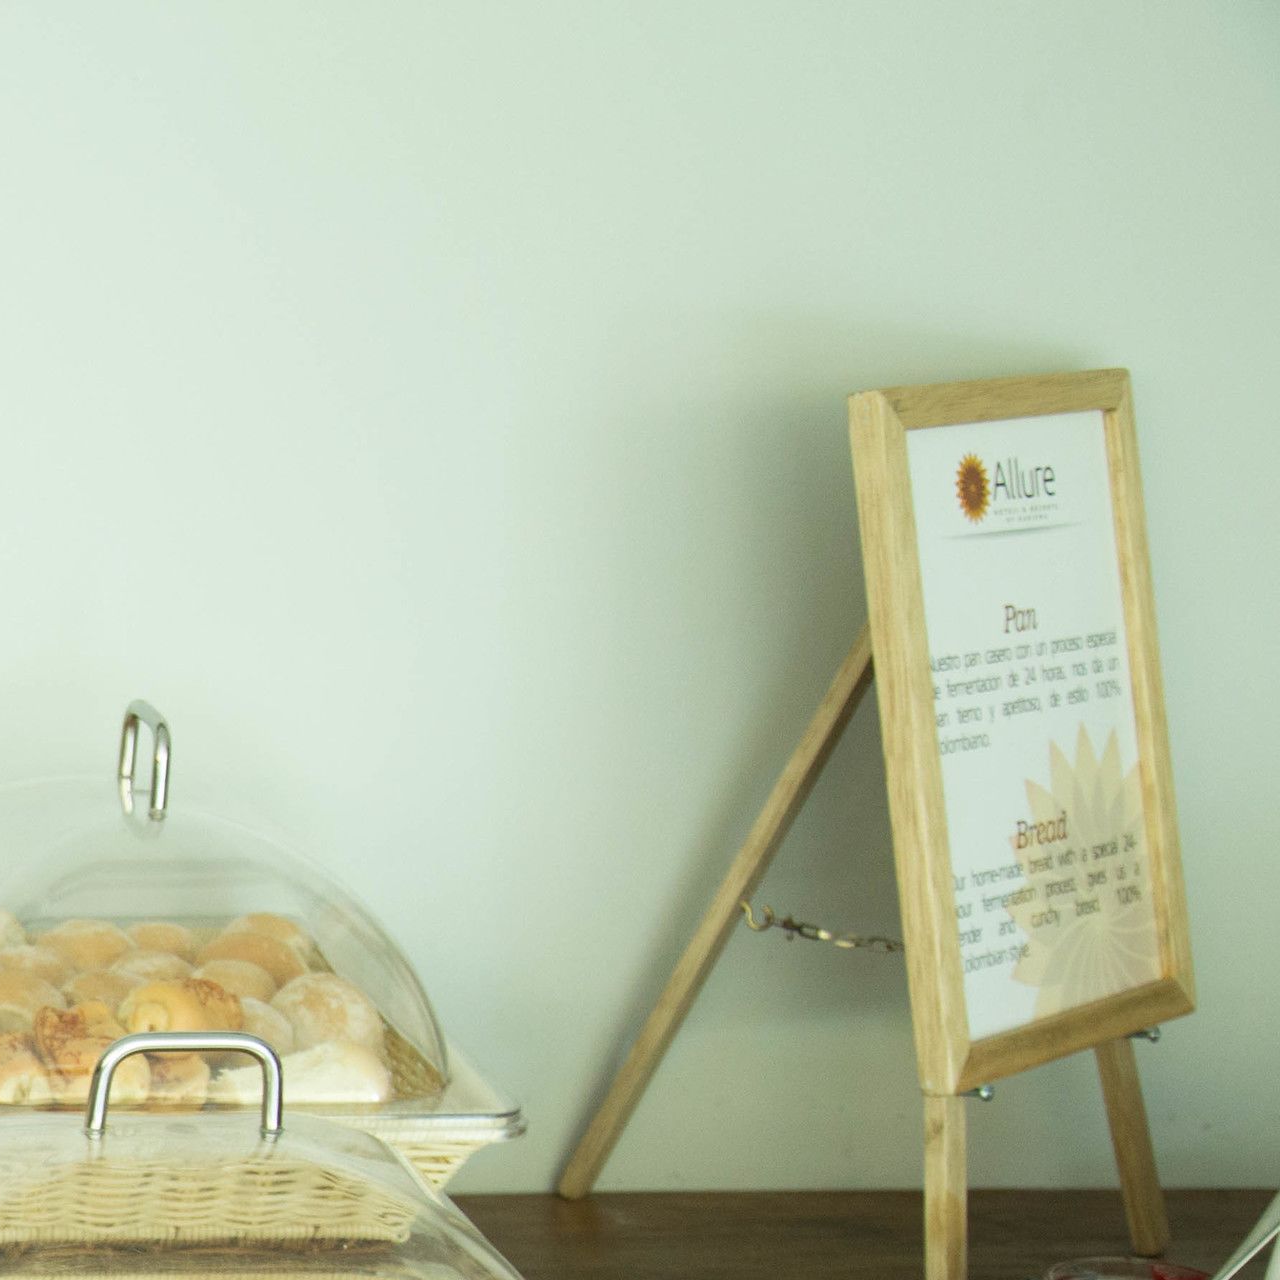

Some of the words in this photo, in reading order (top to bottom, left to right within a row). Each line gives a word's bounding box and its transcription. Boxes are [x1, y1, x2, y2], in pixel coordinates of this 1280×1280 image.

[993, 456, 1056, 501] Allure
[1003, 604, 1038, 634] Pan
[935, 712, 949, 728] an
[1016, 809, 1068, 849] Bread
